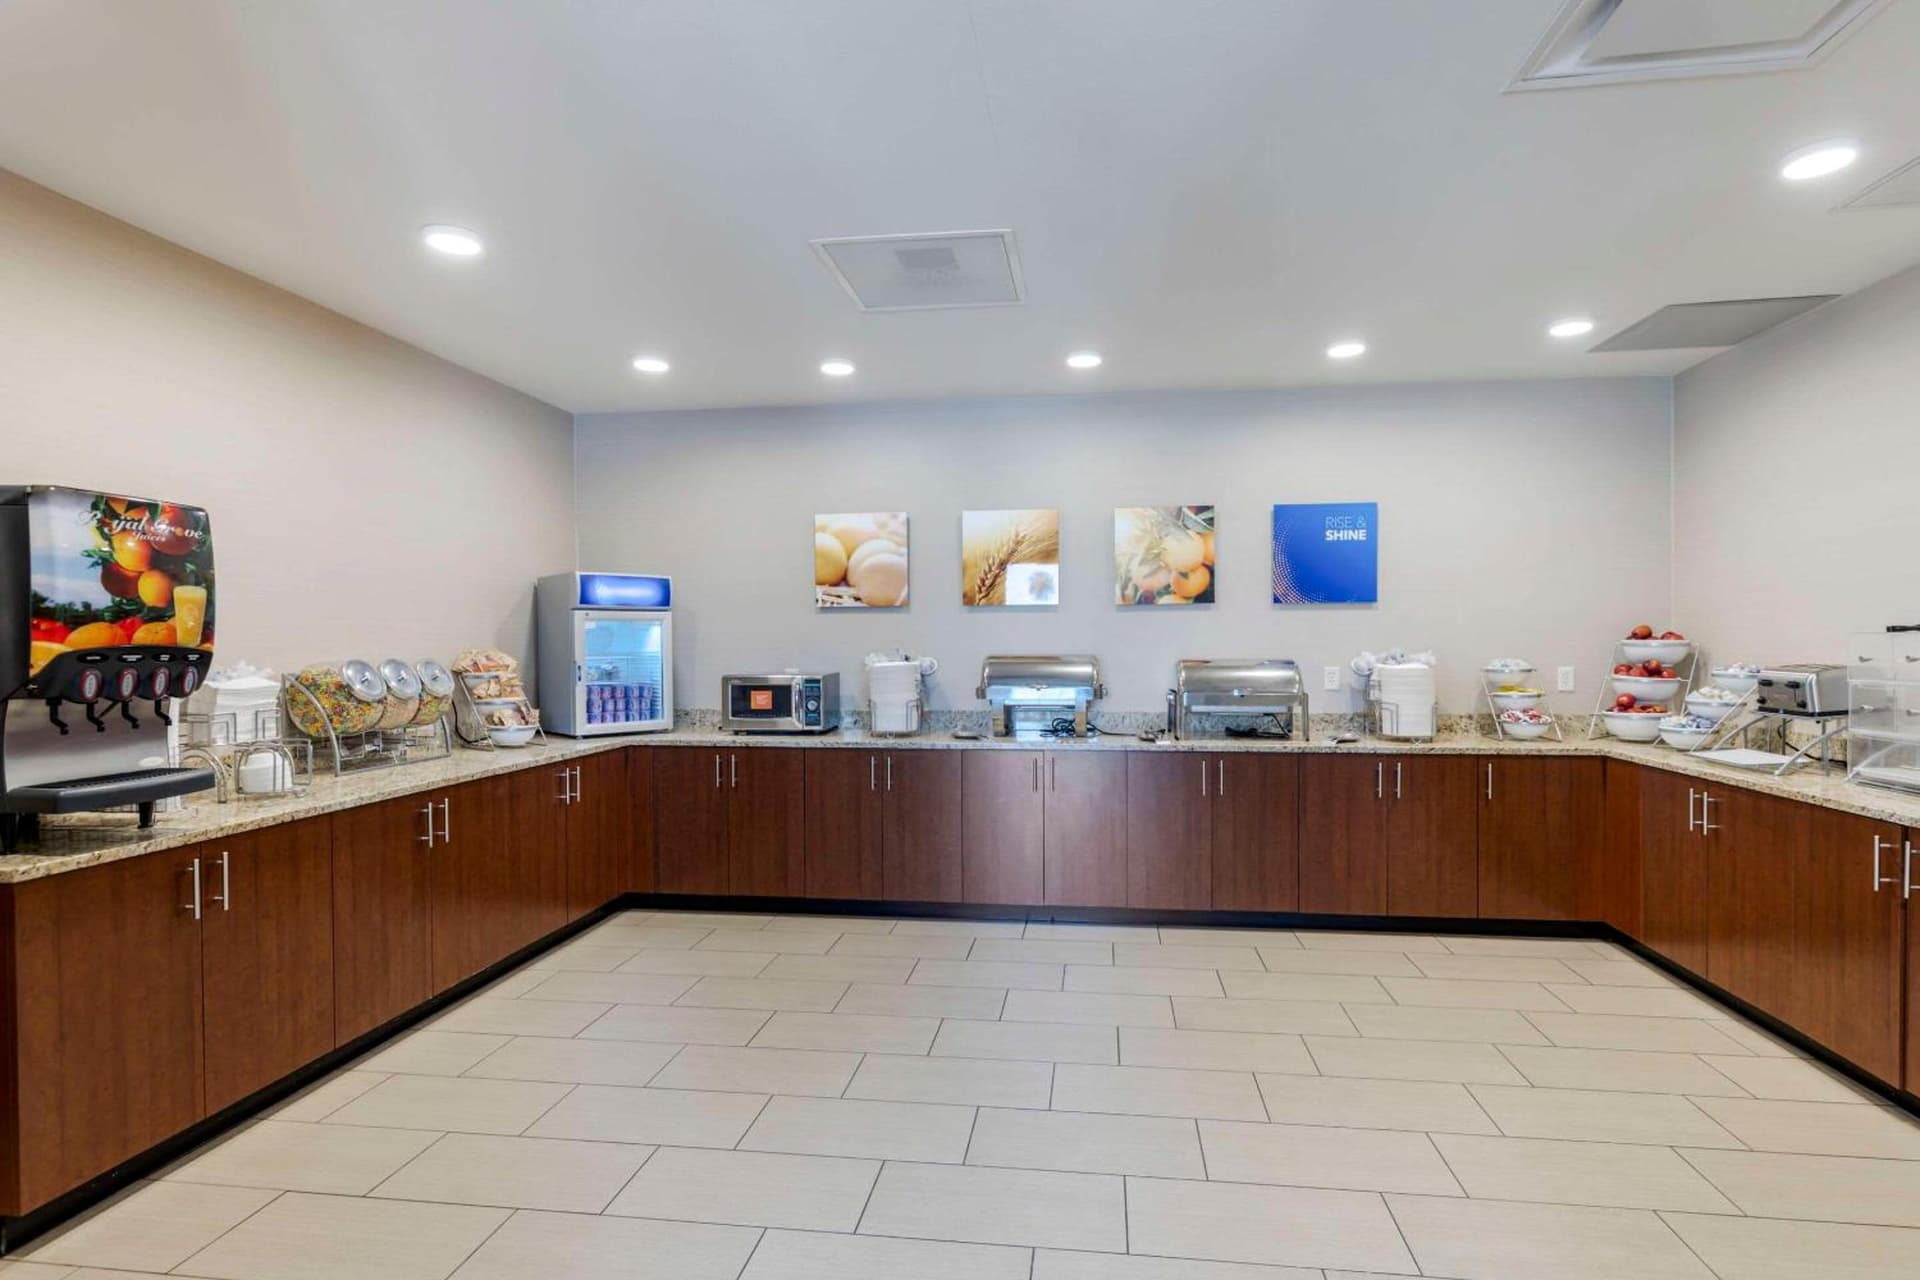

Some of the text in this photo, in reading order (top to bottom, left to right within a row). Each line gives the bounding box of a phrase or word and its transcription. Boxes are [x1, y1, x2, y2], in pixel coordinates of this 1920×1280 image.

[1325, 516, 1367, 528] RISE &
[1325, 529, 1367, 541] SHINE
